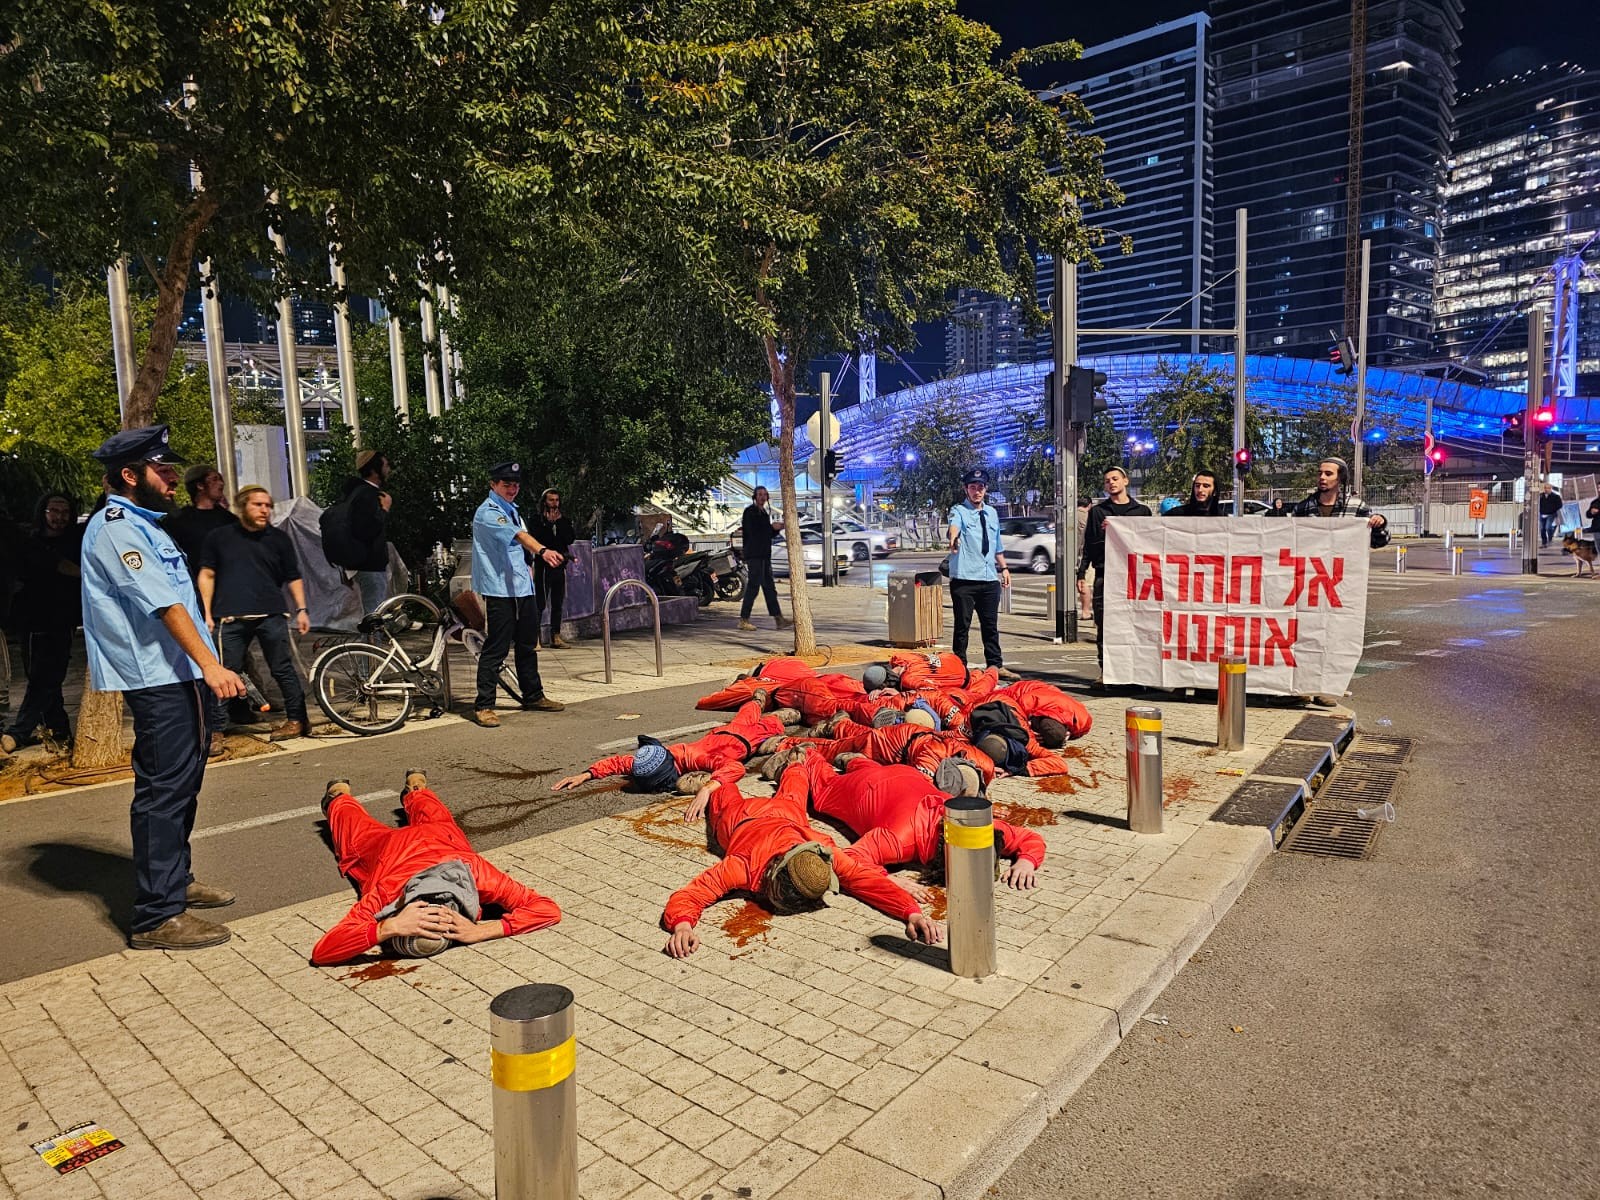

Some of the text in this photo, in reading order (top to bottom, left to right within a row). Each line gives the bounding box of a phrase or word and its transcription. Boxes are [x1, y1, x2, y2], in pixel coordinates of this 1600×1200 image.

[1126, 548, 1345, 608] אל תהרגו
[1161, 610, 1298, 668] אותנו!
